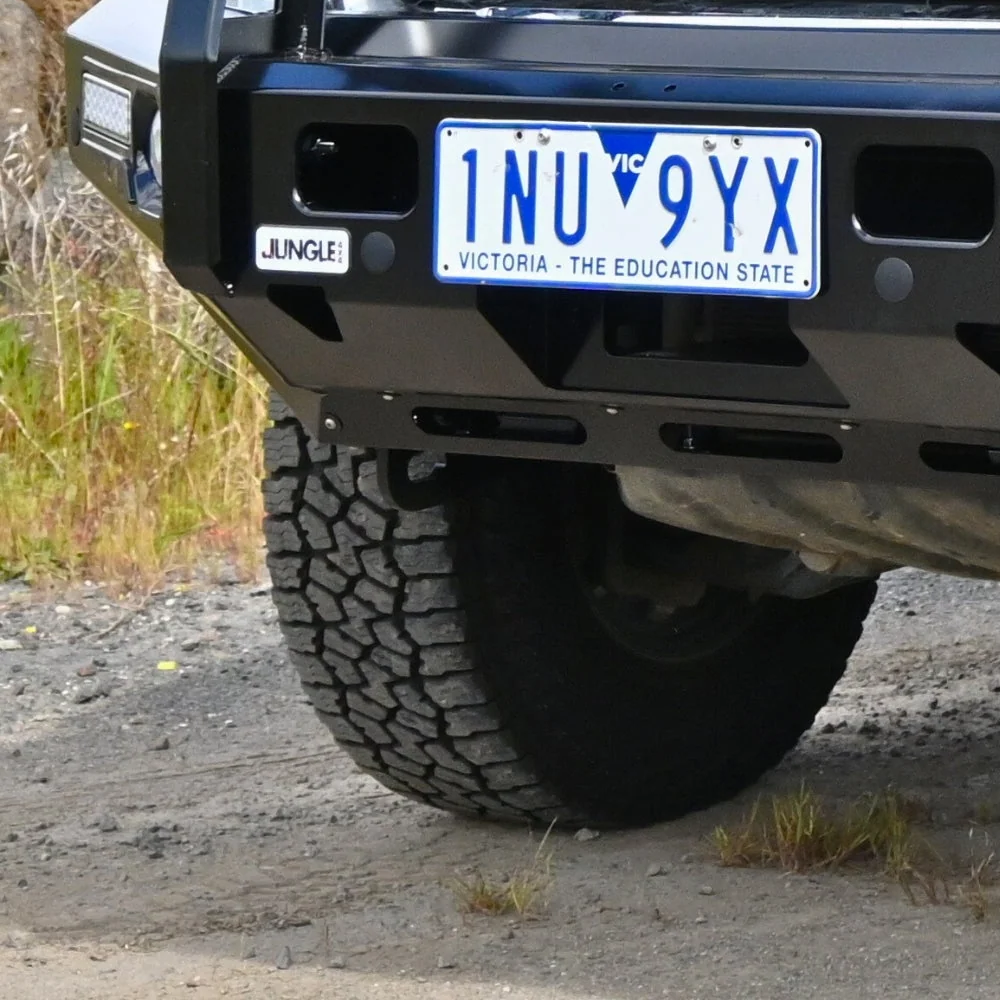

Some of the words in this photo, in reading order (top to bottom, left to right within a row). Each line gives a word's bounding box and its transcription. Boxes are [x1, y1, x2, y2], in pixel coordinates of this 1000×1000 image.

[602, 152, 645, 174] VIC
[461, 148, 588, 246] 1NU
[658, 154, 800, 255] 9YX
[261, 238, 336, 262] JUNGLE
[458, 251, 548, 273] VICTORIA
[569, 255, 606, 276] THE
[614, 257, 729, 281] EDUCATION
[736, 262, 795, 284] STATE
